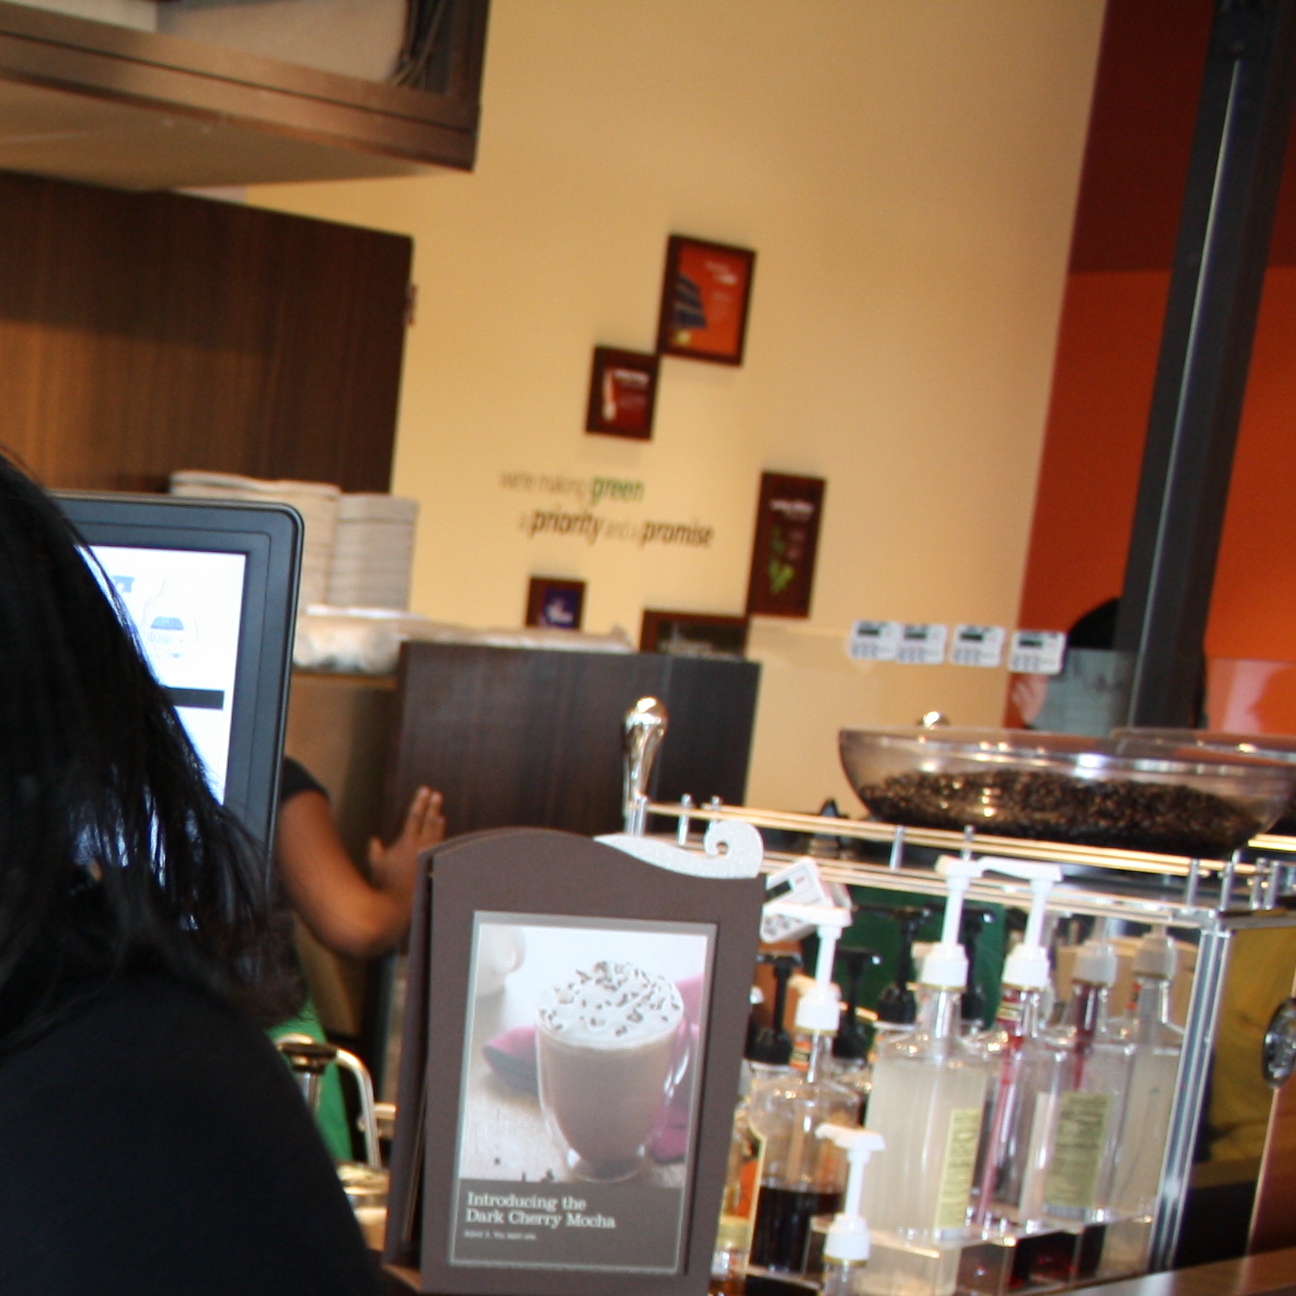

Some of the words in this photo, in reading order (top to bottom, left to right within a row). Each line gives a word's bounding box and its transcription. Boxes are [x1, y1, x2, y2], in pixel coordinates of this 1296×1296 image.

[590, 477, 644, 506] green
[528, 503, 605, 546] priority
[639, 517, 714, 549] promise
[466, 1190, 559, 1213] Introducing
[561, 1195, 587, 1211] the
[465, 1207, 505, 1225] Dark
[507, 1209, 562, 1230] Cherry
[565, 1211, 616, 1230] Mocha
